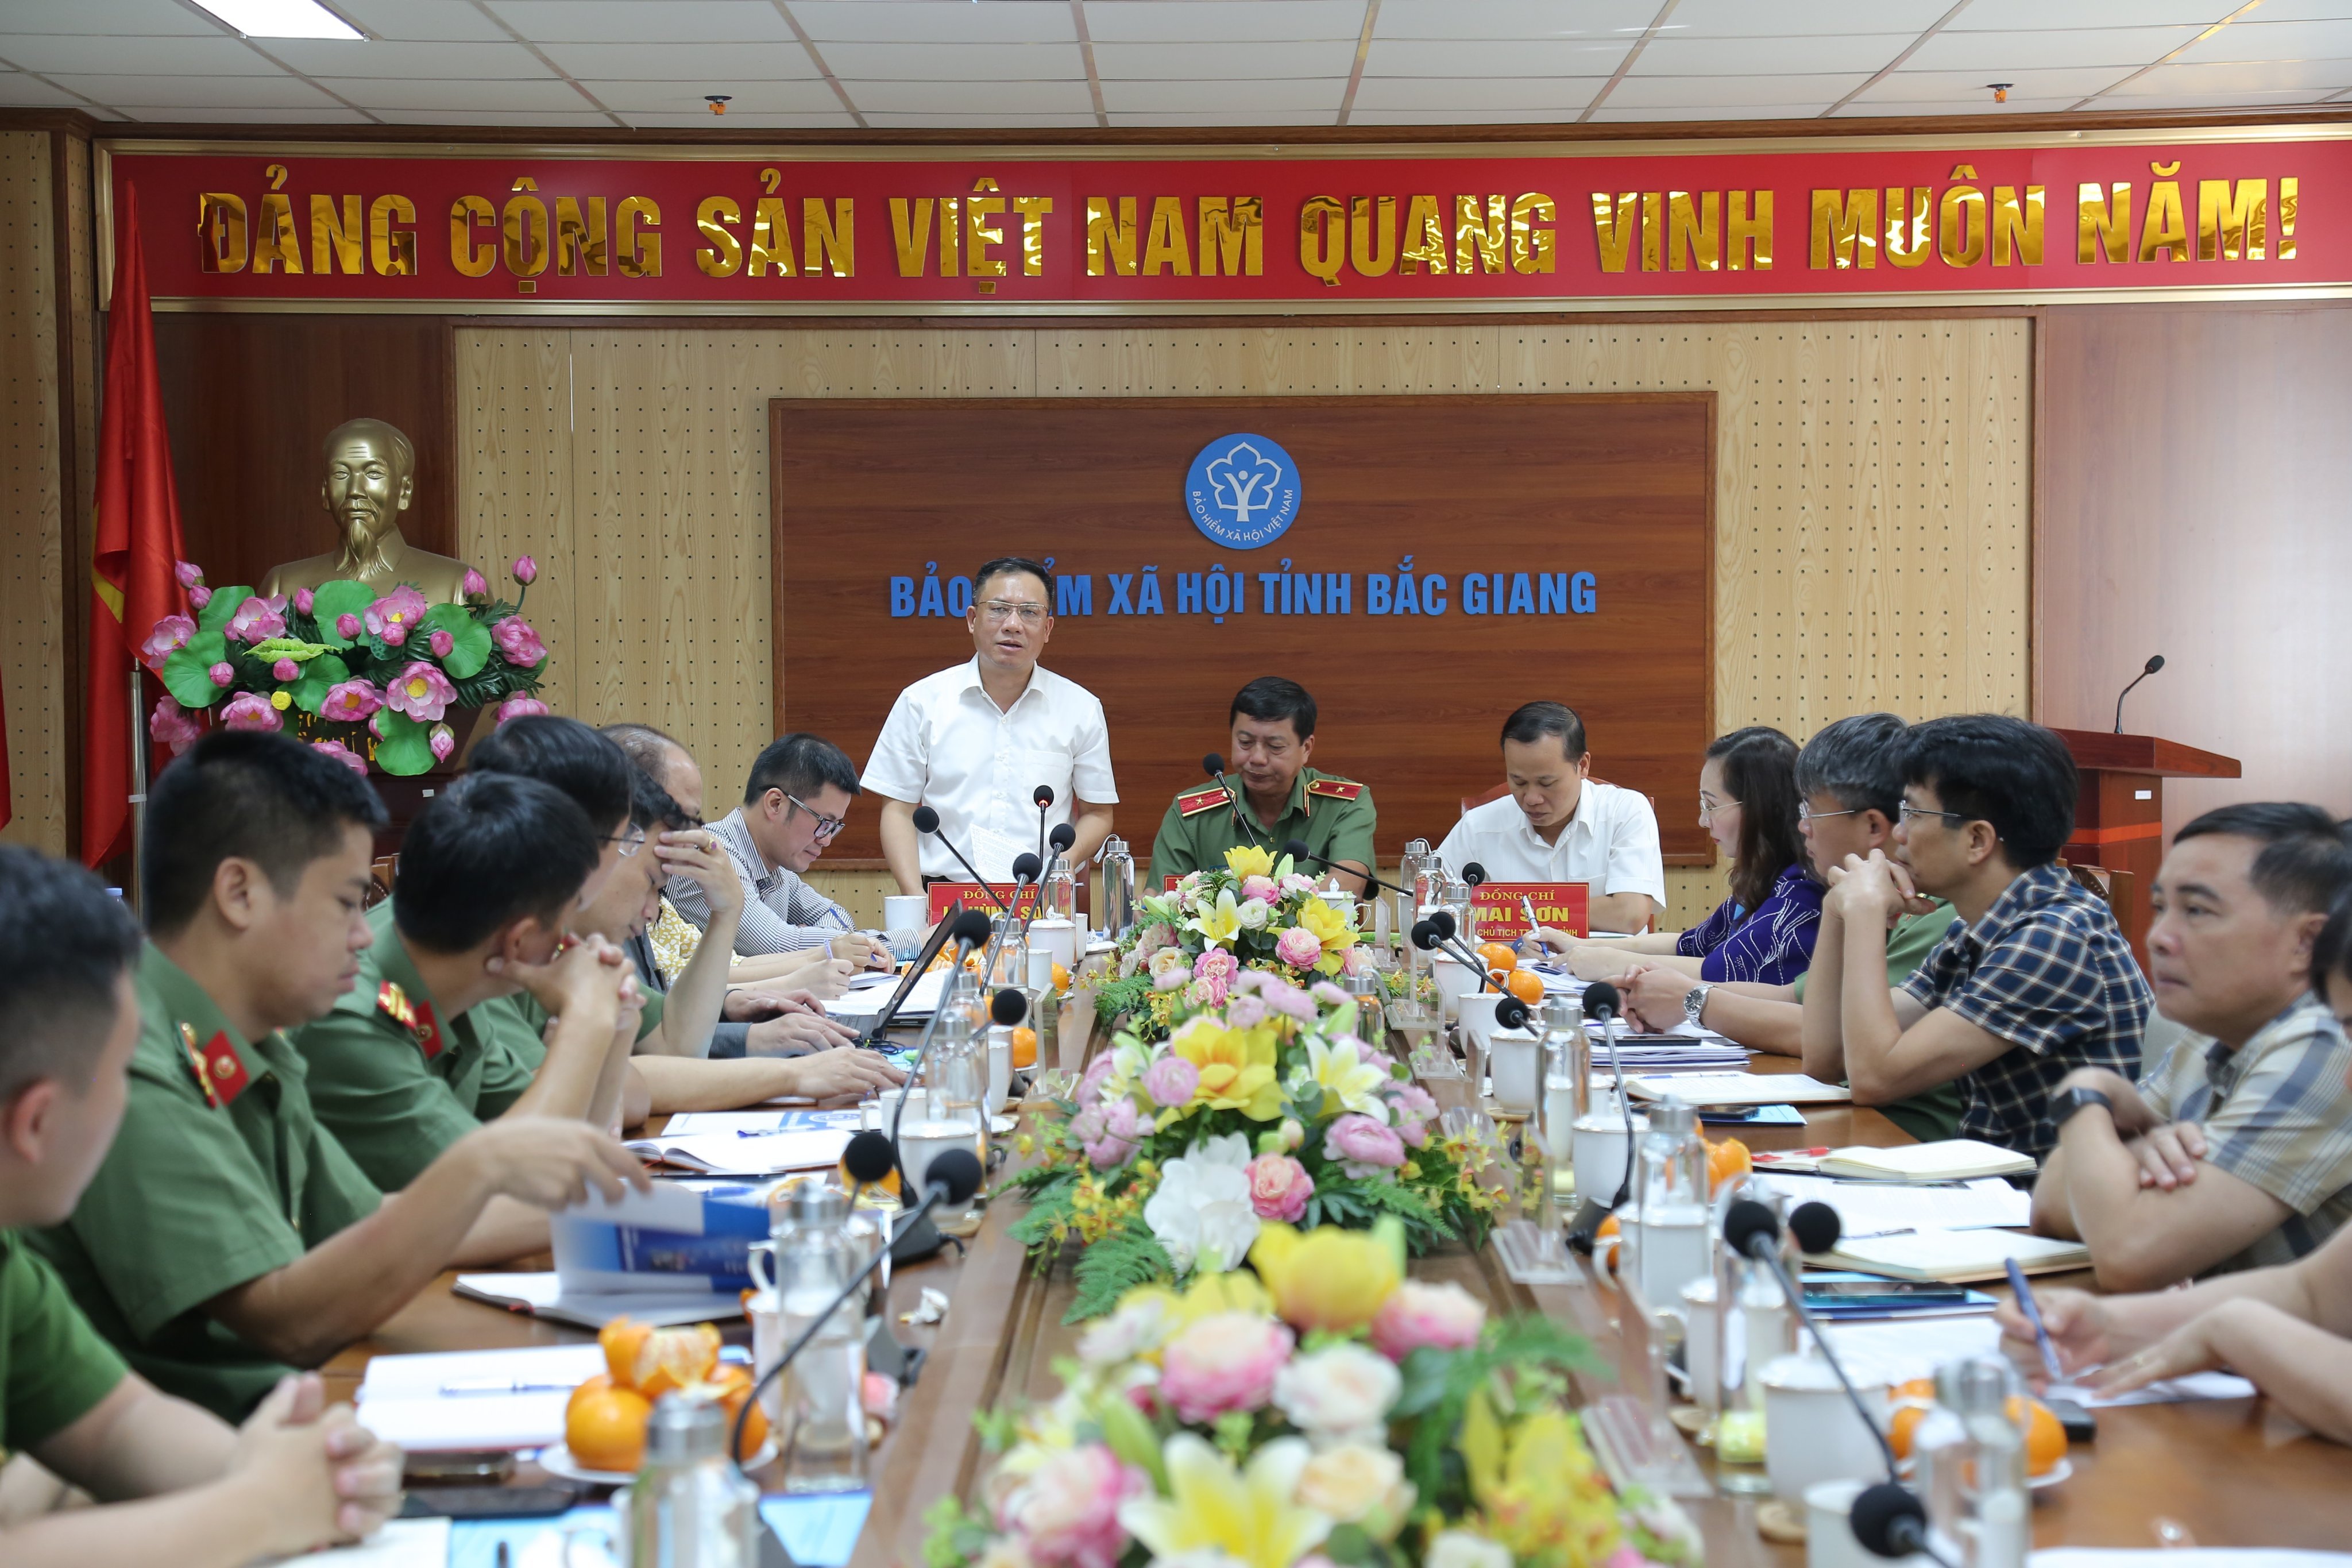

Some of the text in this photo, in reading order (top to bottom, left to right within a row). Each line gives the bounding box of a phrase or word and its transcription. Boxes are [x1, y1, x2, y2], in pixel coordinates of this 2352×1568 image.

[198, 161, 2299, 295] ĐẢNG CỘNG SẢN VIỆT NAM QUANG VINH MUÔN NĂM!
[1192, 489, 1293, 542] BẢO HIỂM XÃ HỘI VIỆT NAM
[890, 561, 973, 617] BẢO
[1107, 565, 1164, 615] XÃ
[1177, 563, 1244, 624] HỘI
[1258, 558, 1351, 615] TỈNH
[1367, 555, 1447, 616] BẮC
[1462, 571, 1597, 615] GIANG
[1480, 888, 1555, 901] ĐỒNG CHÍ
[1474, 907, 1512, 922] MAI
[1477, 926, 1495, 936] CHỦ
[1497, 929, 1517, 937] TỊCH
